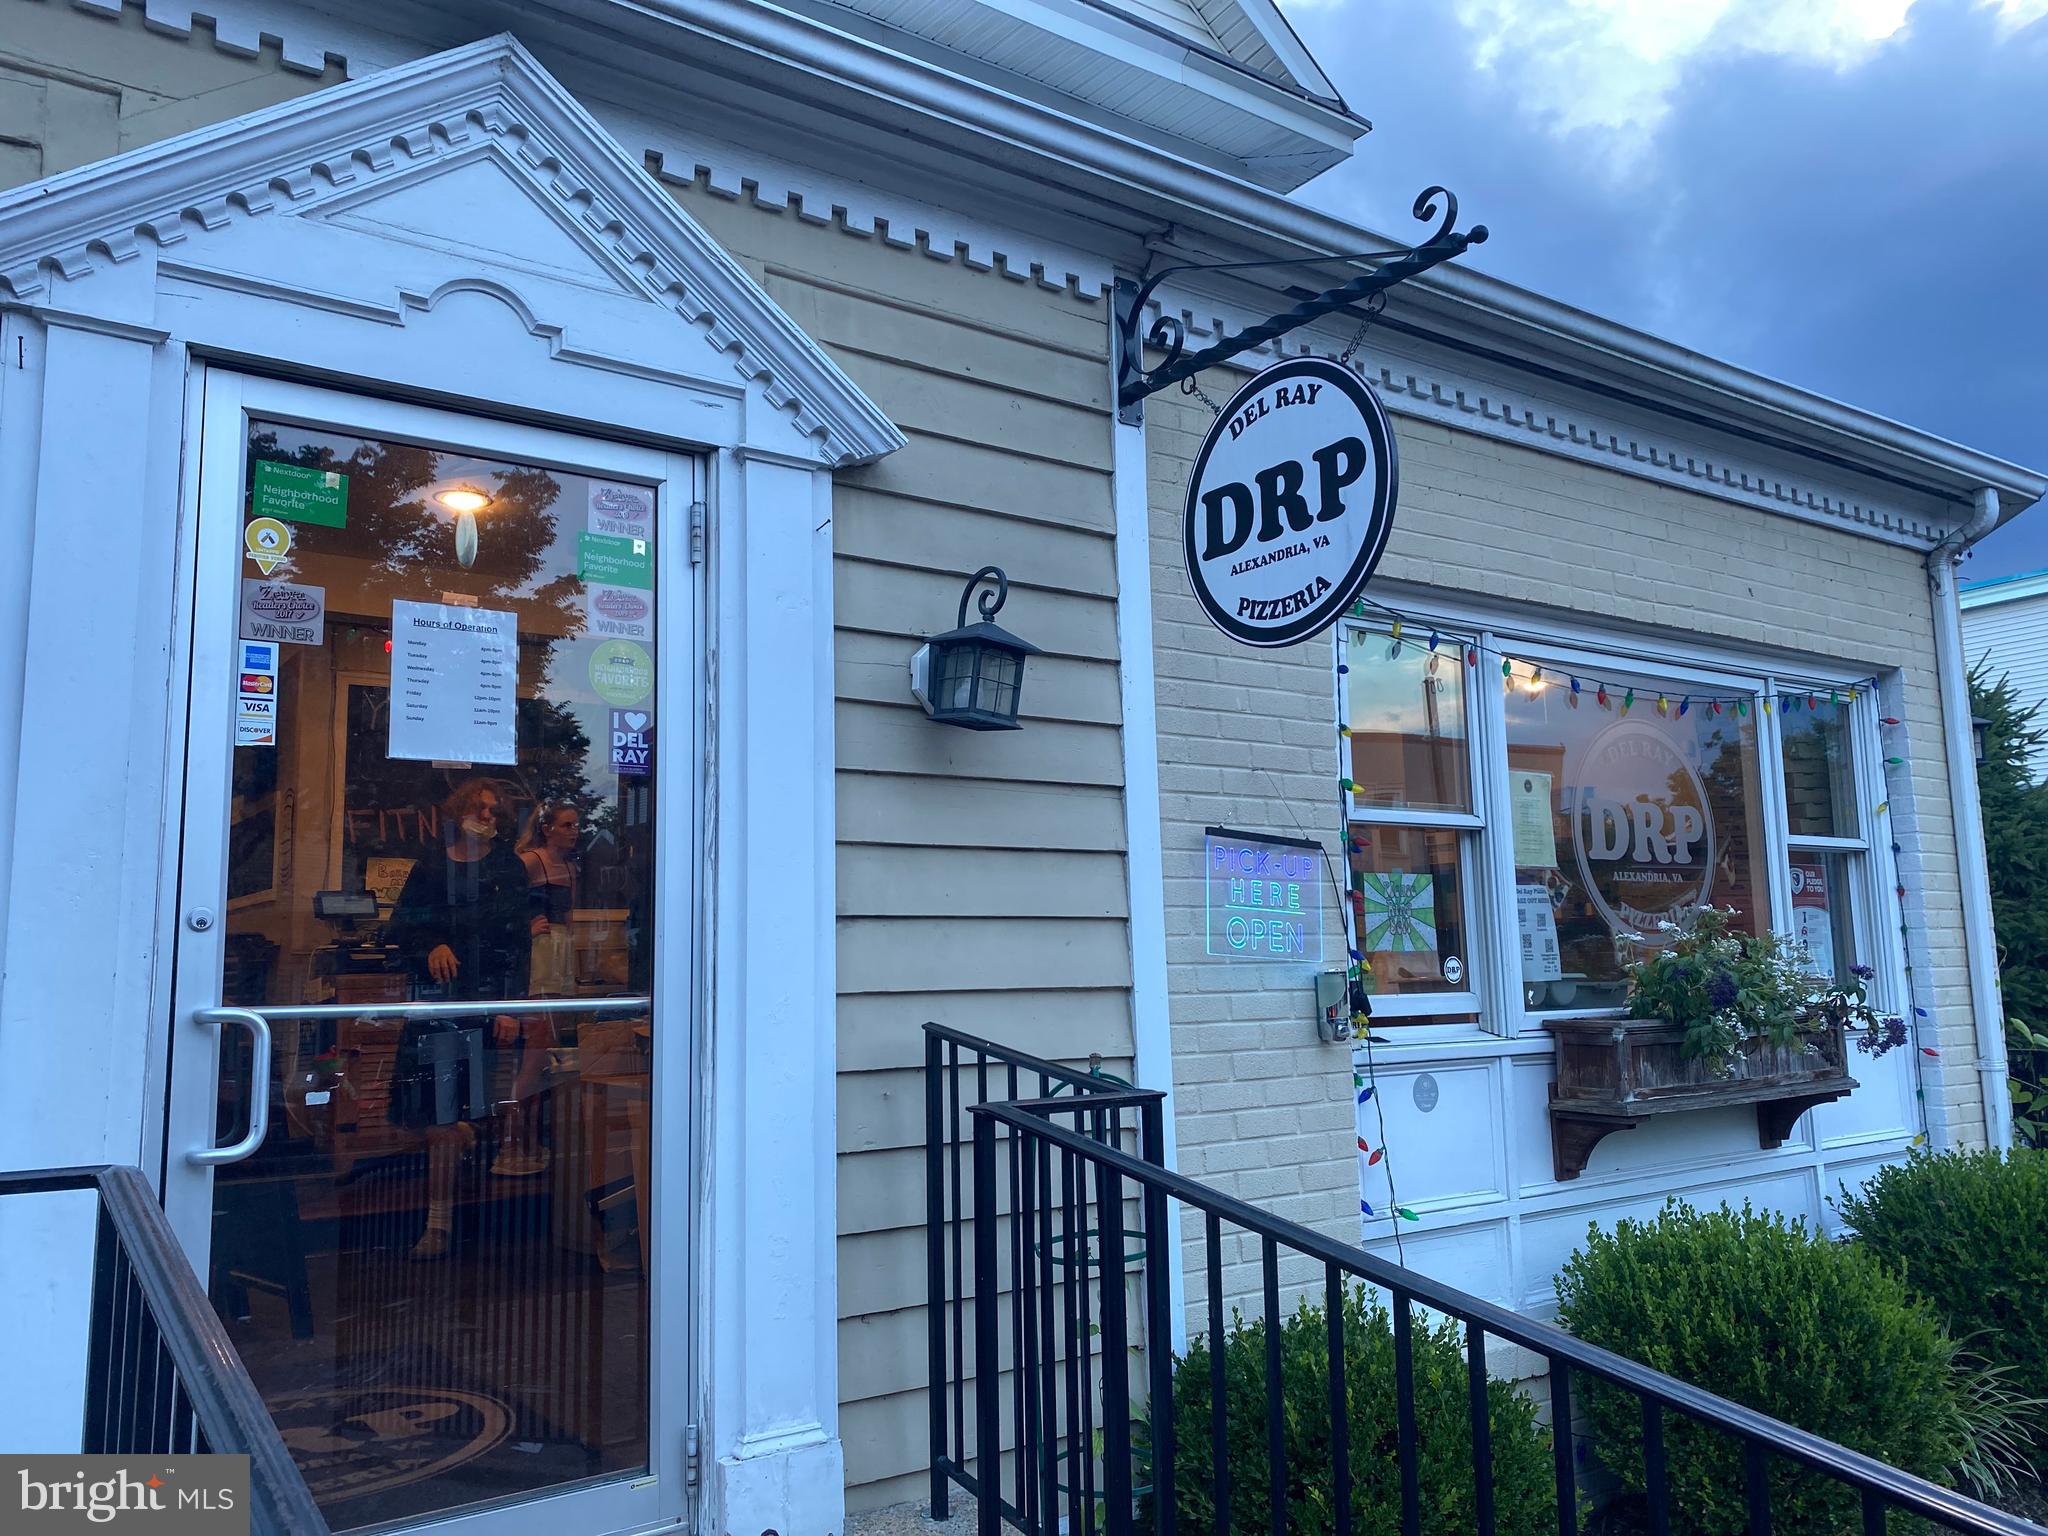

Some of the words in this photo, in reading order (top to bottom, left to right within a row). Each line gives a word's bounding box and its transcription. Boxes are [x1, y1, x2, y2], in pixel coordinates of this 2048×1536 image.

[1228, 397, 1270, 440] DEL
[1275, 383, 1322, 409] RAY
[273, 467, 311, 479] Nextdoor
[262, 495, 305, 509] Favorite
[263, 484, 339, 505] Neighborhood
[1201, 436, 1367, 561] DRP
[597, 519, 645, 537] WINNER
[584, 552, 645, 568] Neighborhood
[1230, 542, 1310, 576] ALEXANDRIA,
[1313, 534, 1331, 549] VA
[583, 561, 618, 574] Favorite
[287, 601, 315, 611] Choice
[1237, 576, 1332, 621] PIZZERIA
[250, 622, 314, 642] WINNER
[413, 618, 440, 628] Hours
[443, 621, 452, 629] of
[454, 622, 498, 634] Operation
[597, 620, 645, 637] WINNER
[242, 680, 272, 688] MasterCard
[595, 672, 649, 688] FAVORITE
[244, 702, 270, 712] VISA
[613, 712, 619, 728] I
[239, 726, 271, 734] DISCOVER
[613, 731, 648, 748] DEL
[612, 749, 648, 764] RAY
[1607, 740, 1637, 761] DEL
[1641, 741, 1673, 767] RAY
[1588, 798, 1704, 864] DRP
[1215, 846, 1313, 880] PICK-UP
[1613, 871, 1671, 884] ALEXANDRIA,
[1673, 872, 1684, 883] VA
[1805, 870, 1816, 878] OUR
[1806, 878, 1823, 886] PLEDGE
[1231, 877, 1300, 909] HERE
[1227, 916, 1304, 954] OPEN
[1447, 966, 1460, 974] DRP
